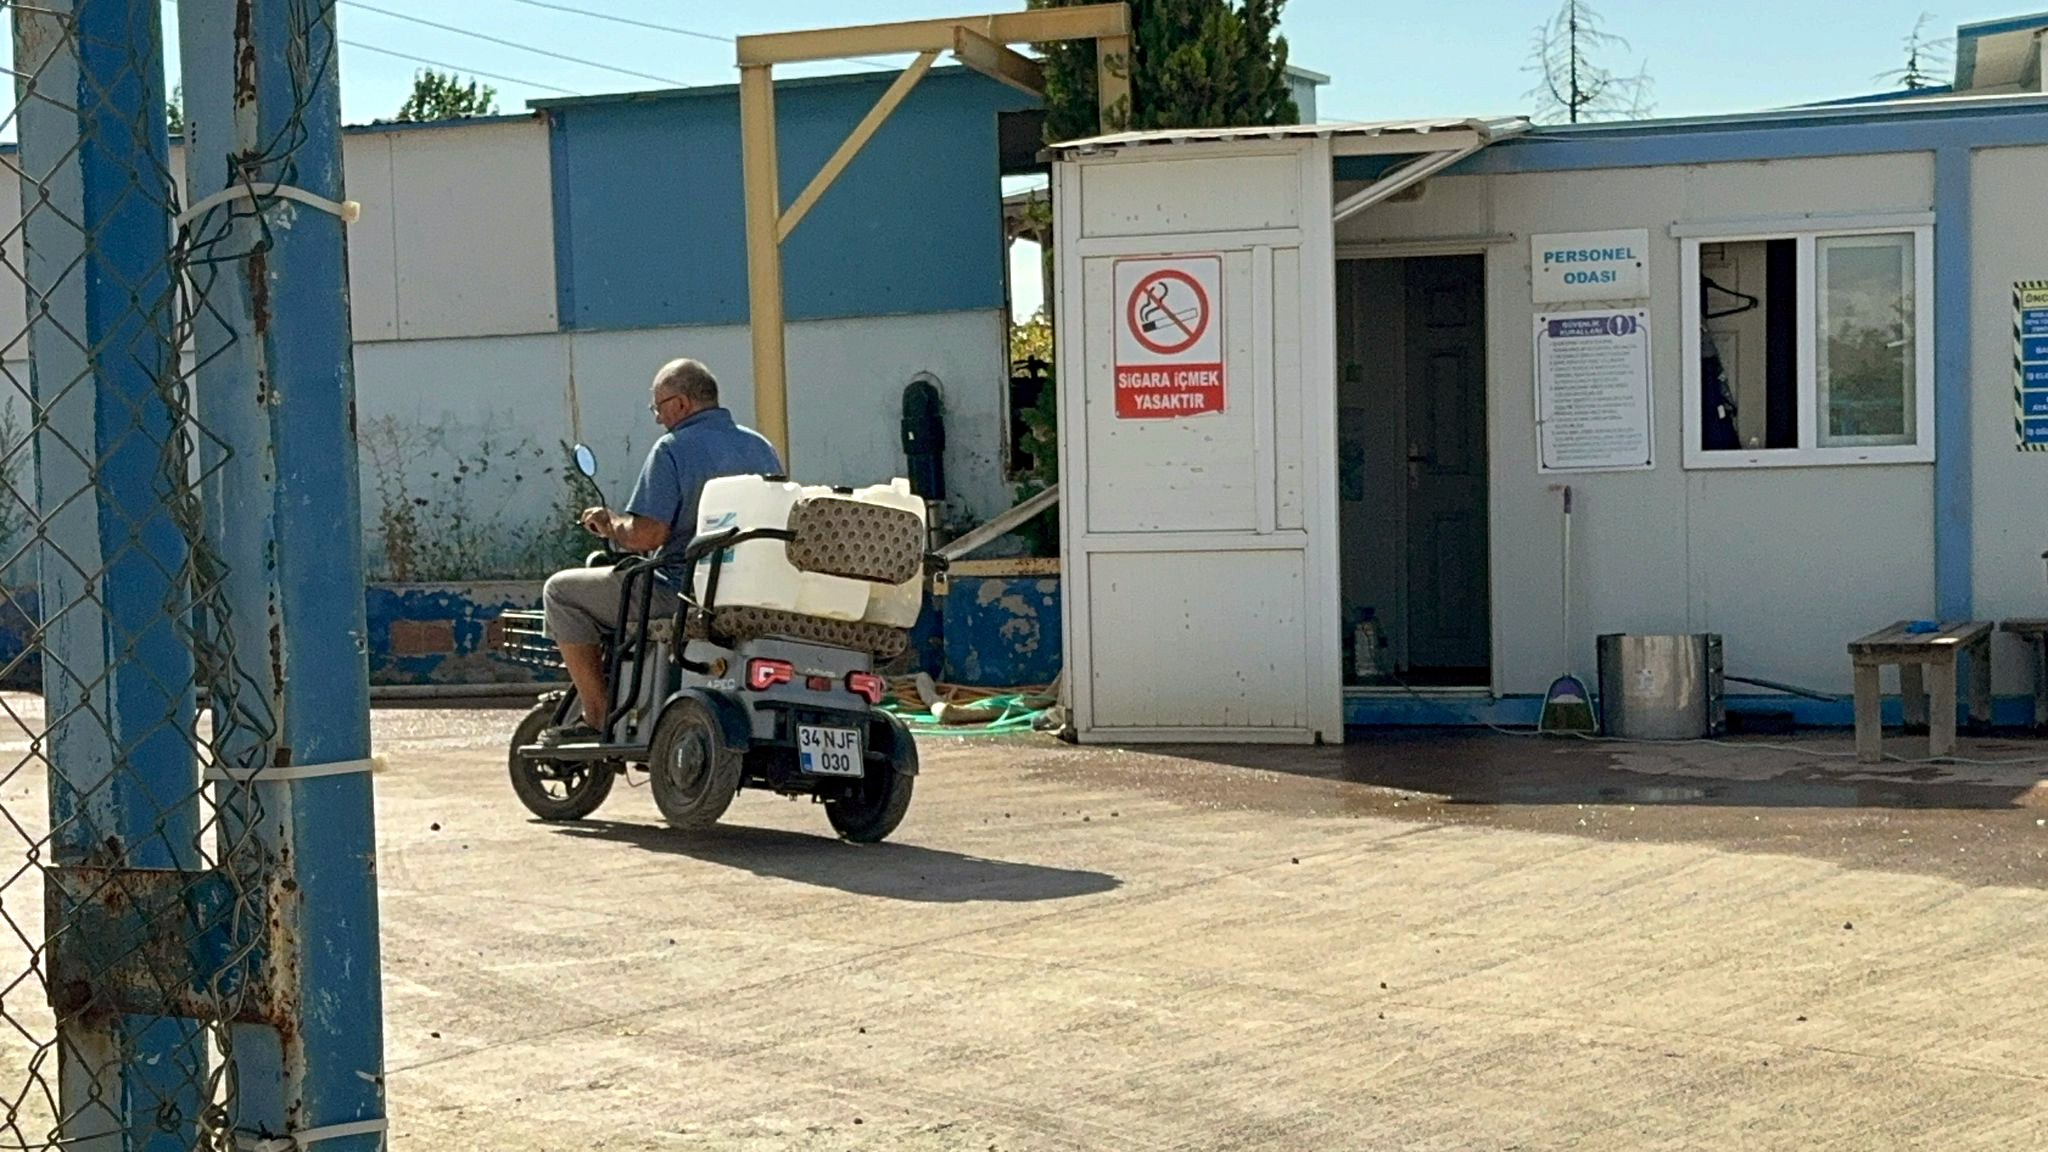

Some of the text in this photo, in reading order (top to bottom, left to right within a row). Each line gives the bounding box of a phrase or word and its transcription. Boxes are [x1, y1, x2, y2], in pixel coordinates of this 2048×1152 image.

[1544, 247, 1637, 263] PERSONEL
[1563, 270, 1617, 284] ODASI
[1133, 393, 1205, 409] YASAKTIR
[801, 728, 856, 749] 34 NJF
[821, 752, 850, 771] 030
